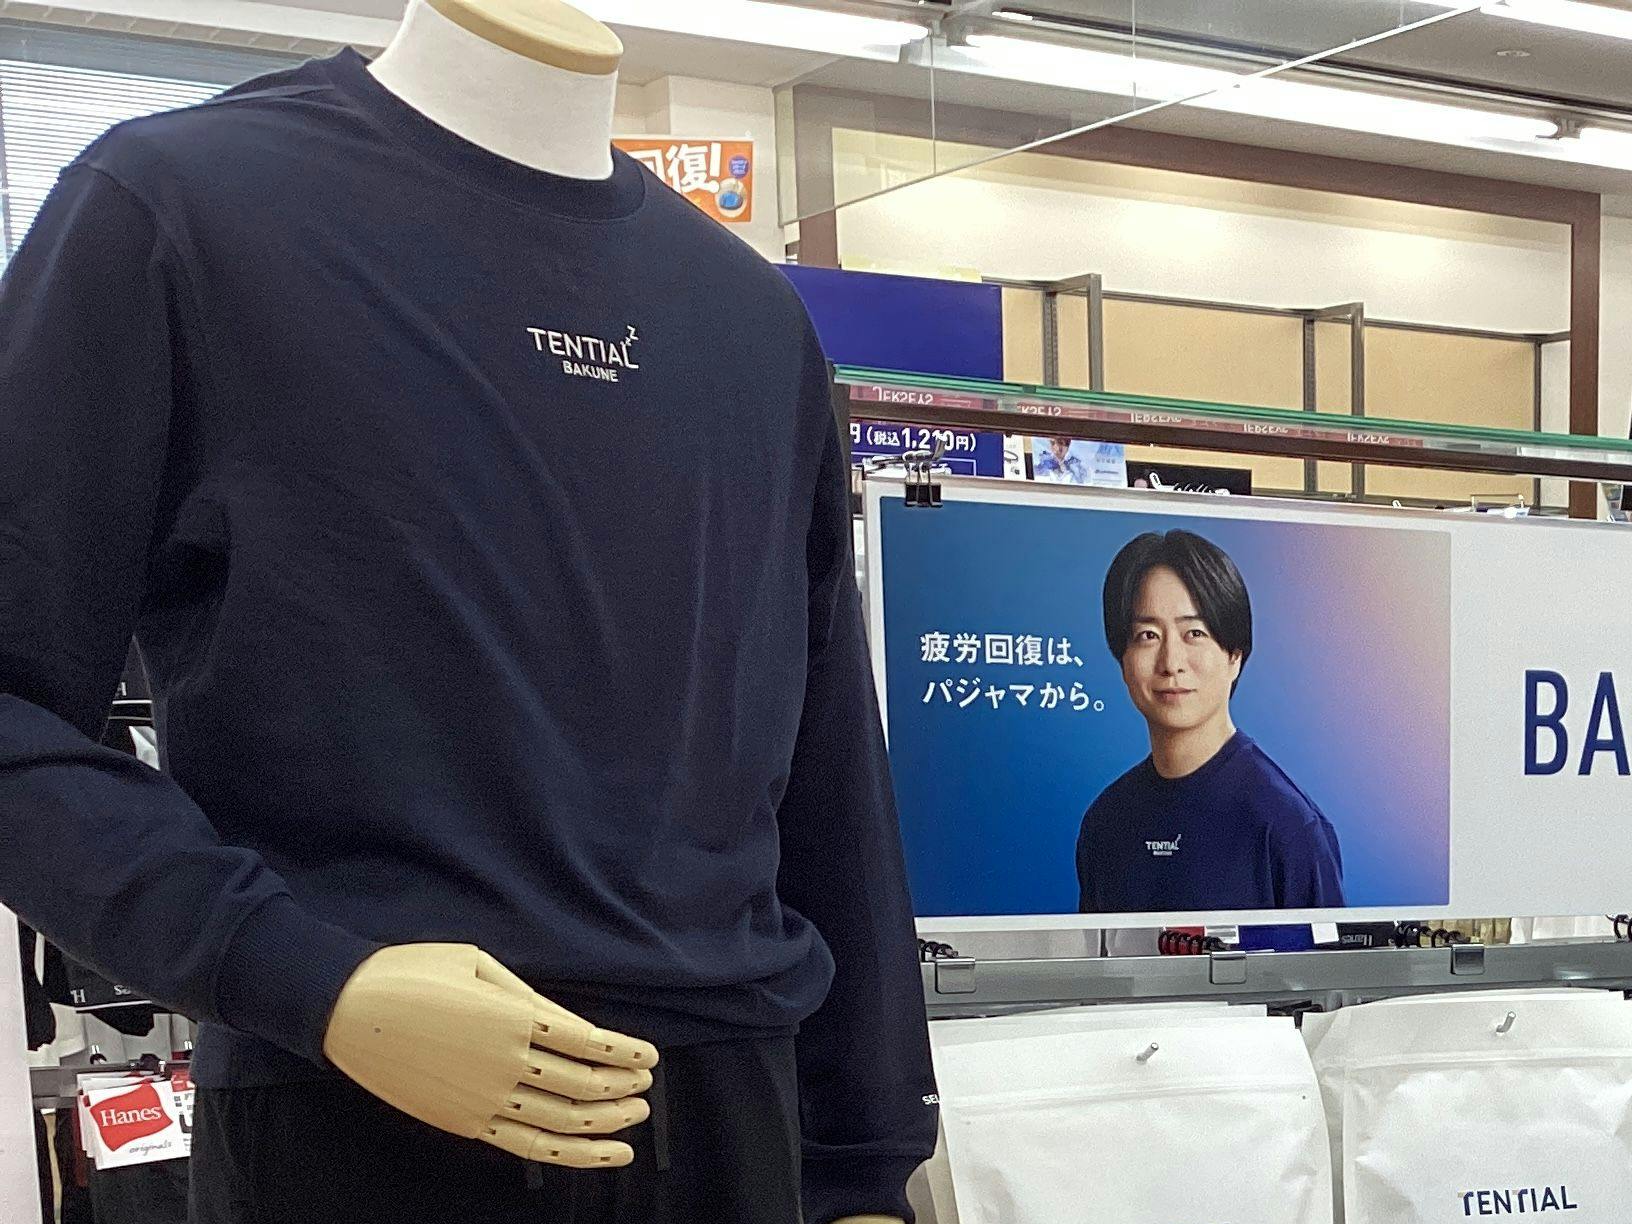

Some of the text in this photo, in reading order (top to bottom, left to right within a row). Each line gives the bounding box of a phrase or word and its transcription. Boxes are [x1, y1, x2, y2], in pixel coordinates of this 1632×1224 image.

[527, 327, 639, 369] TENTIAL
[562, 360, 619, 382] BAKUNE
[920, 631, 1084, 667] 疲労回復は、
[922, 677, 1105, 712] パジャマから。
[100, 1106, 161, 1127] Hanes
[129, 1139, 172, 1156] originals
[1457, 1185, 1578, 1216] TENTIAL
